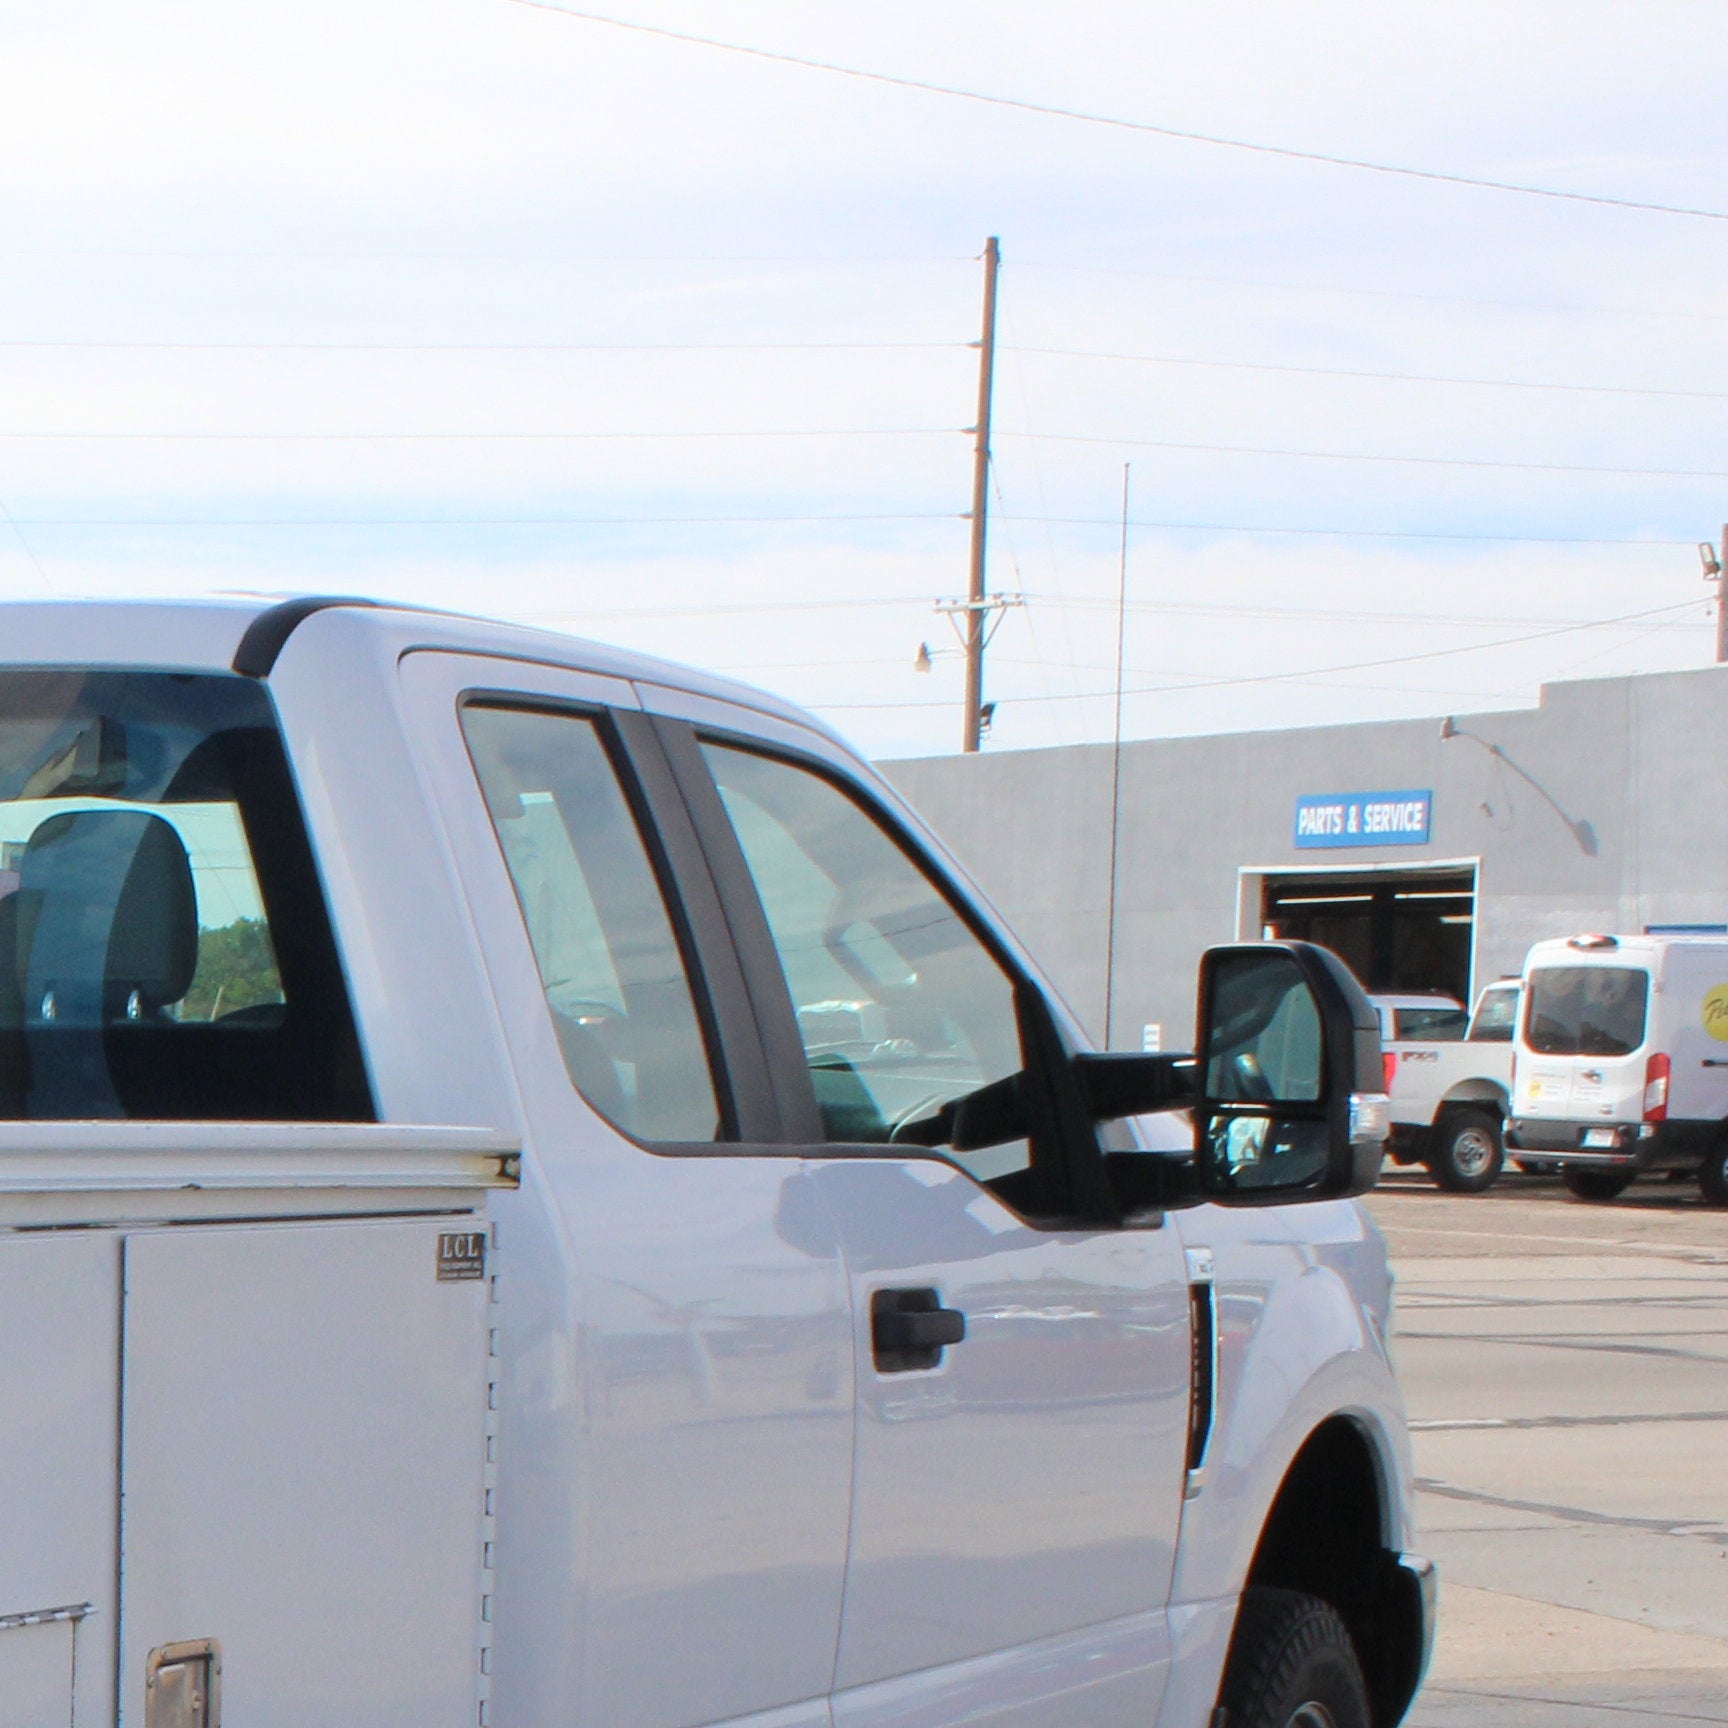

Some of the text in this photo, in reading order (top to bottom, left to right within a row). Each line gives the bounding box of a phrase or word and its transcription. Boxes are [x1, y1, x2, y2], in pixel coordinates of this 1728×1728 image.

[1297, 802, 1424, 836] PARTS & SERVICE
[443, 1235, 479, 1258] LCL
